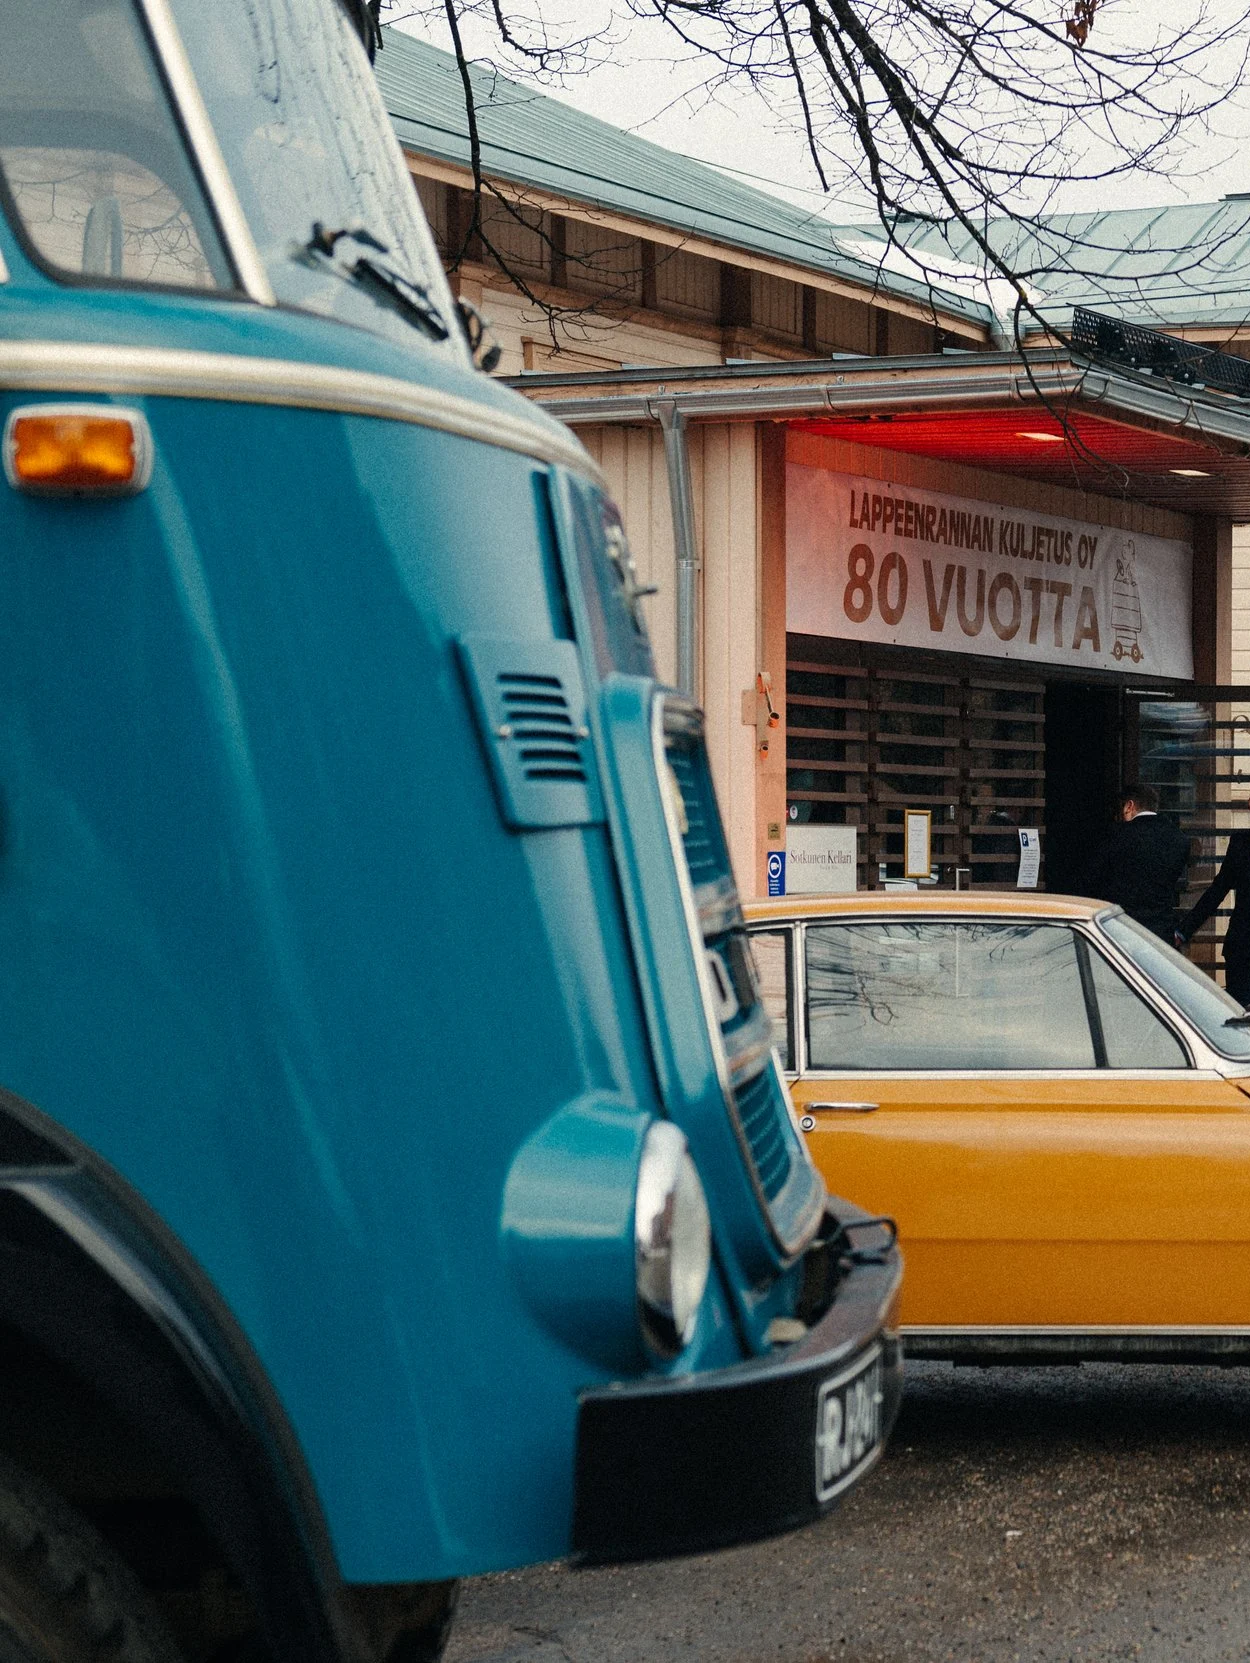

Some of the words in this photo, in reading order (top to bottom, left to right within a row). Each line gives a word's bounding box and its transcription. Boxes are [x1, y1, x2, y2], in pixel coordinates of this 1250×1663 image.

[849, 489, 994, 553] LAPPEENRANNAN
[999, 521, 1072, 564] KULJETUS
[1077, 535, 1098, 570] OY
[843, 543, 909, 626] 80
[922, 559, 1101, 652] VUOTTA
